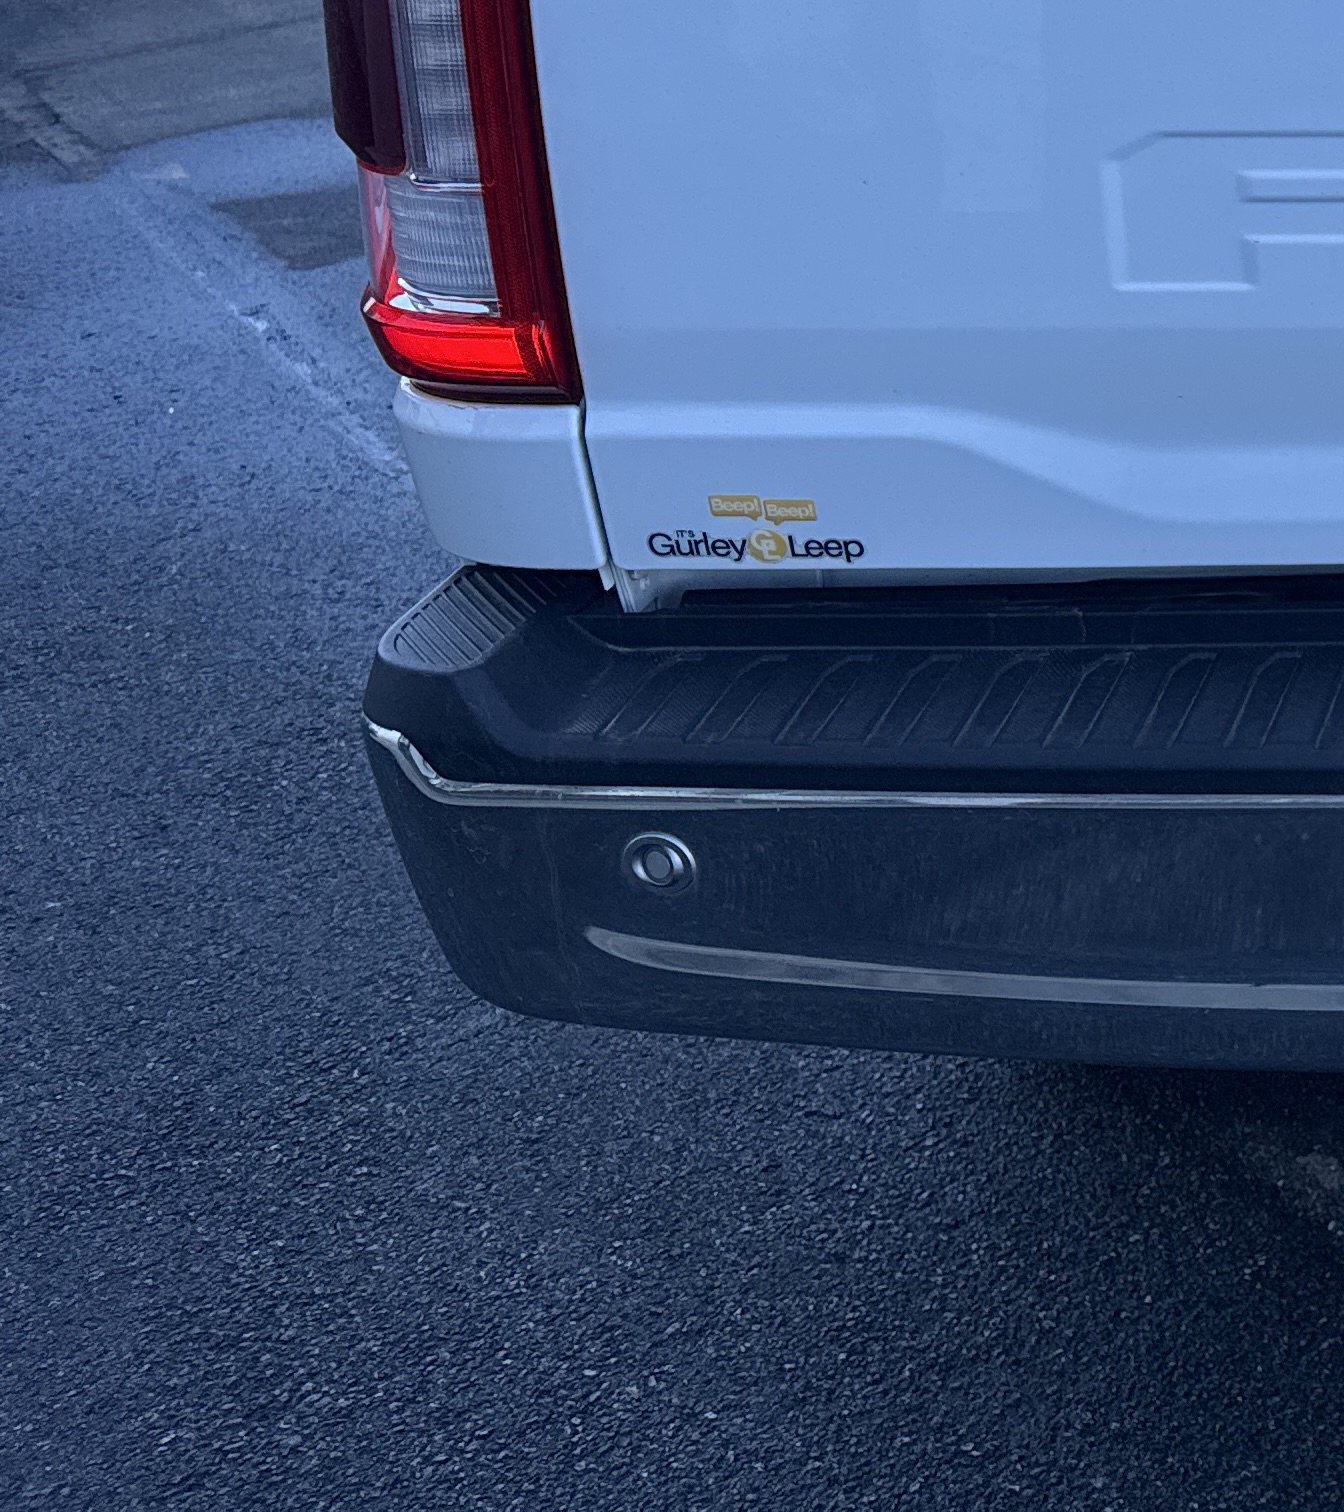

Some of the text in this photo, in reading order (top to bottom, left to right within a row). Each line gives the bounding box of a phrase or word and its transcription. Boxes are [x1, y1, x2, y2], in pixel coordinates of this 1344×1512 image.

[709, 498, 760, 514] Beep!
[765, 503, 814, 519] Beep!
[648, 531, 747, 562] Gurley
[787, 535, 865, 564] Leep
